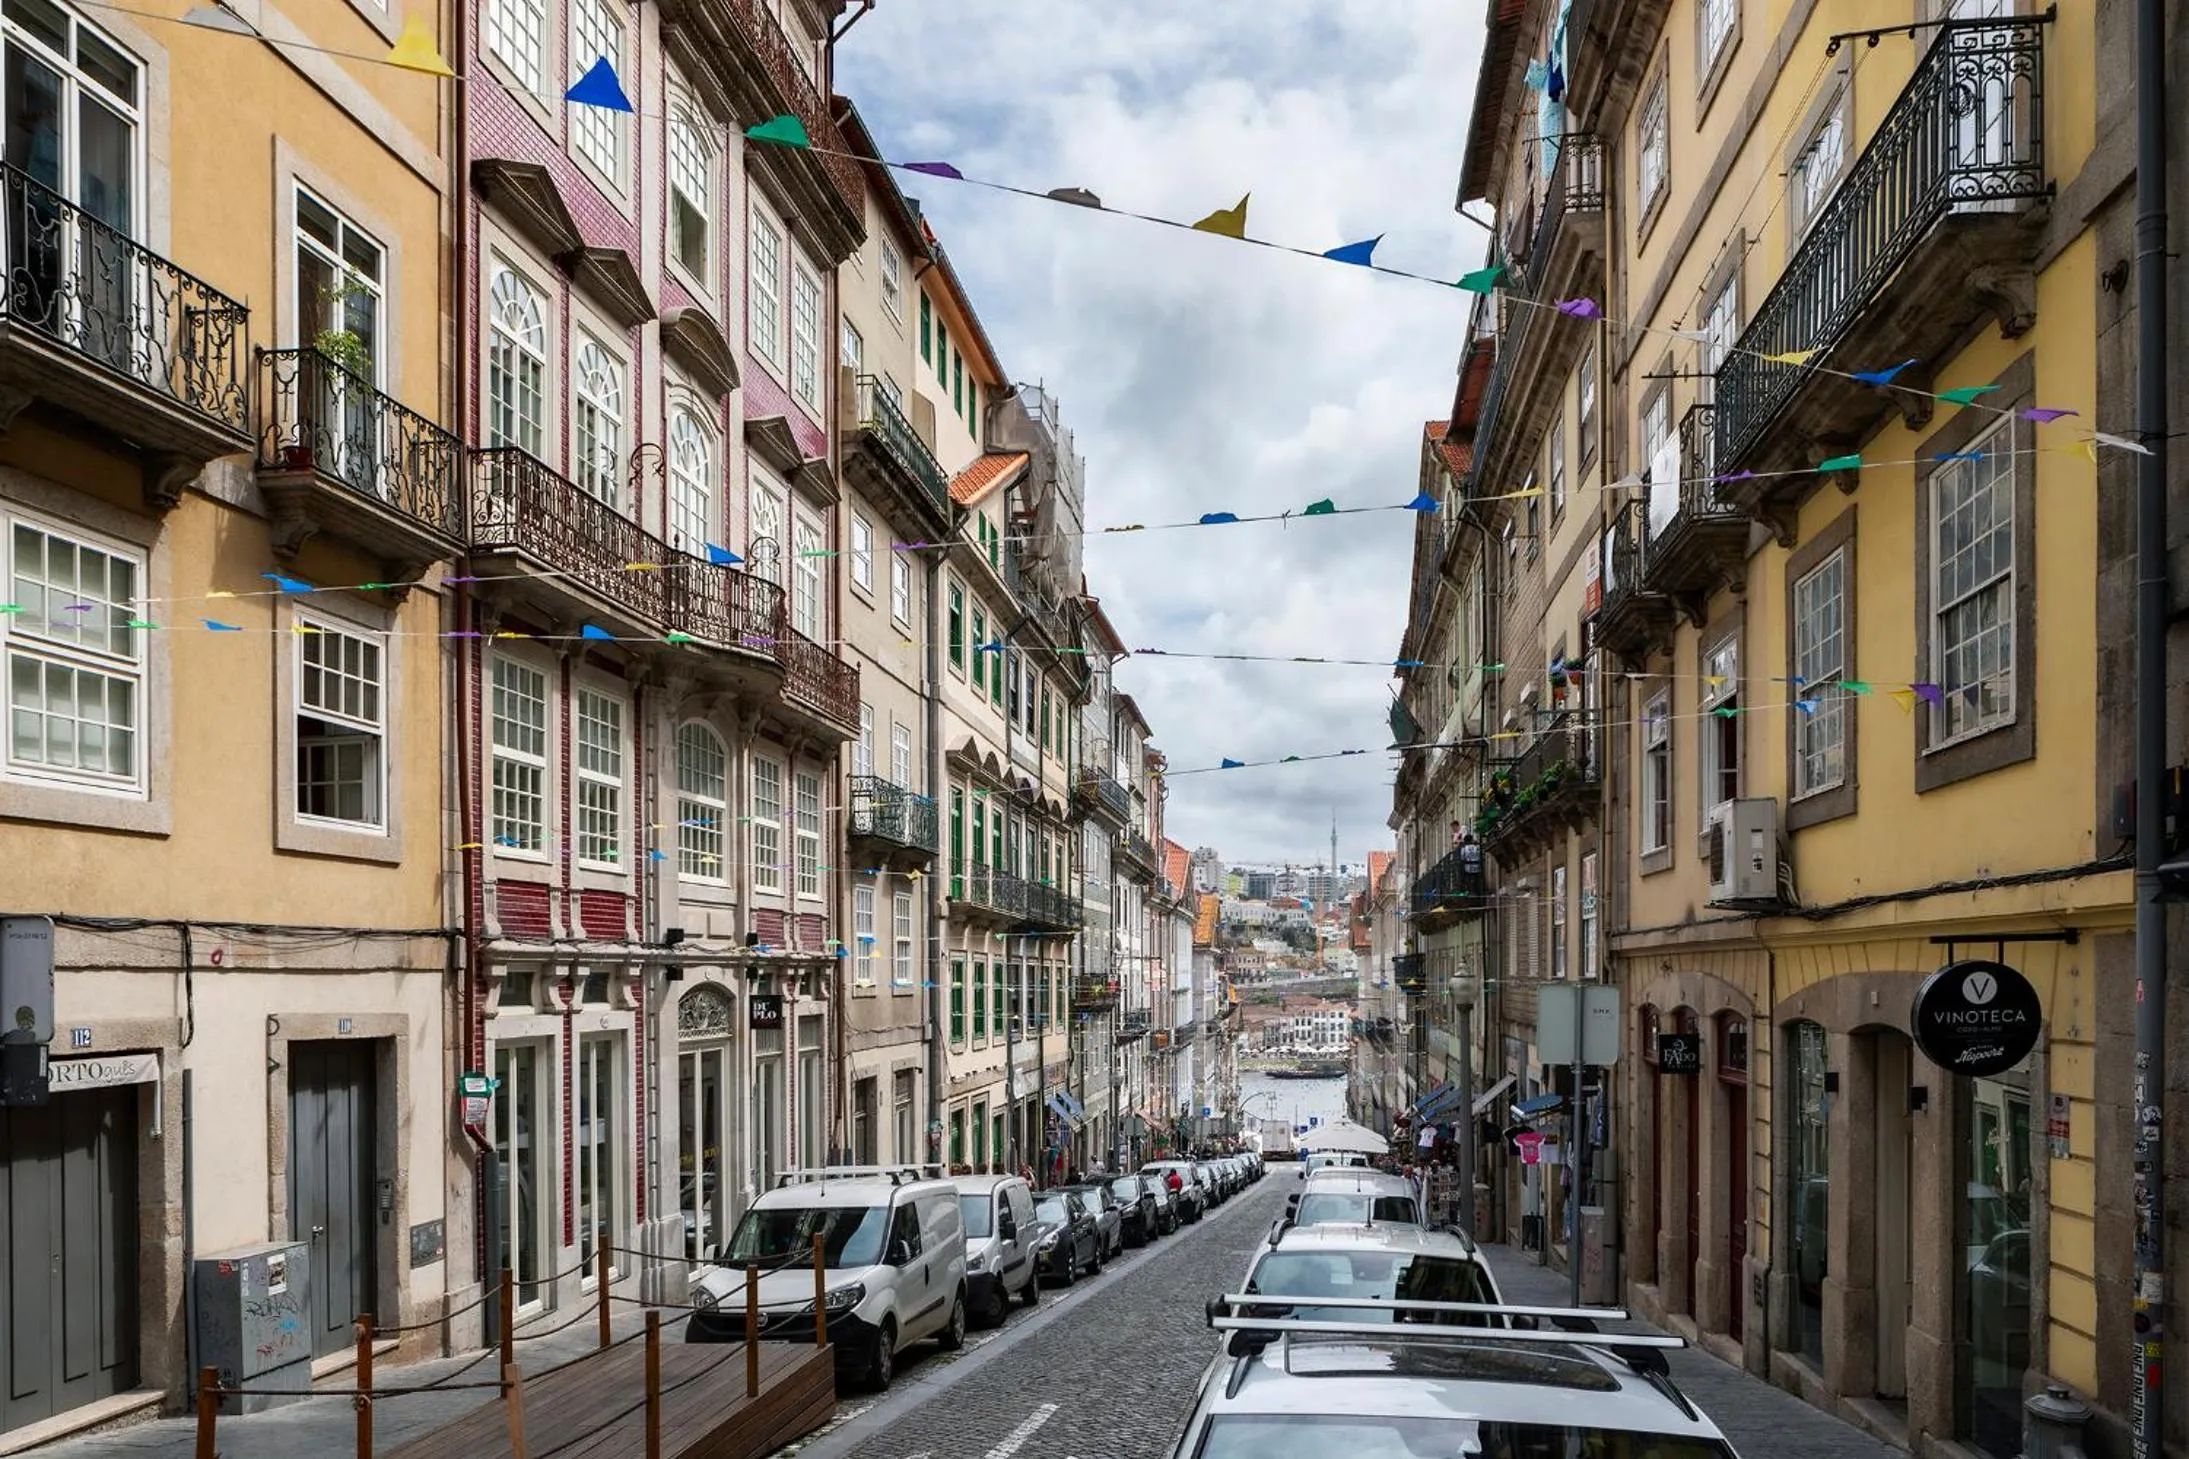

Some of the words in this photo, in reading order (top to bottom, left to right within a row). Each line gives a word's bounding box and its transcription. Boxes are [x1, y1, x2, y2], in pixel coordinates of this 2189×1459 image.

[1970, 978, 1990, 1000] V
[1933, 1009, 2026, 1024] VINOTECA
[74, 1029, 91, 1046] 112
